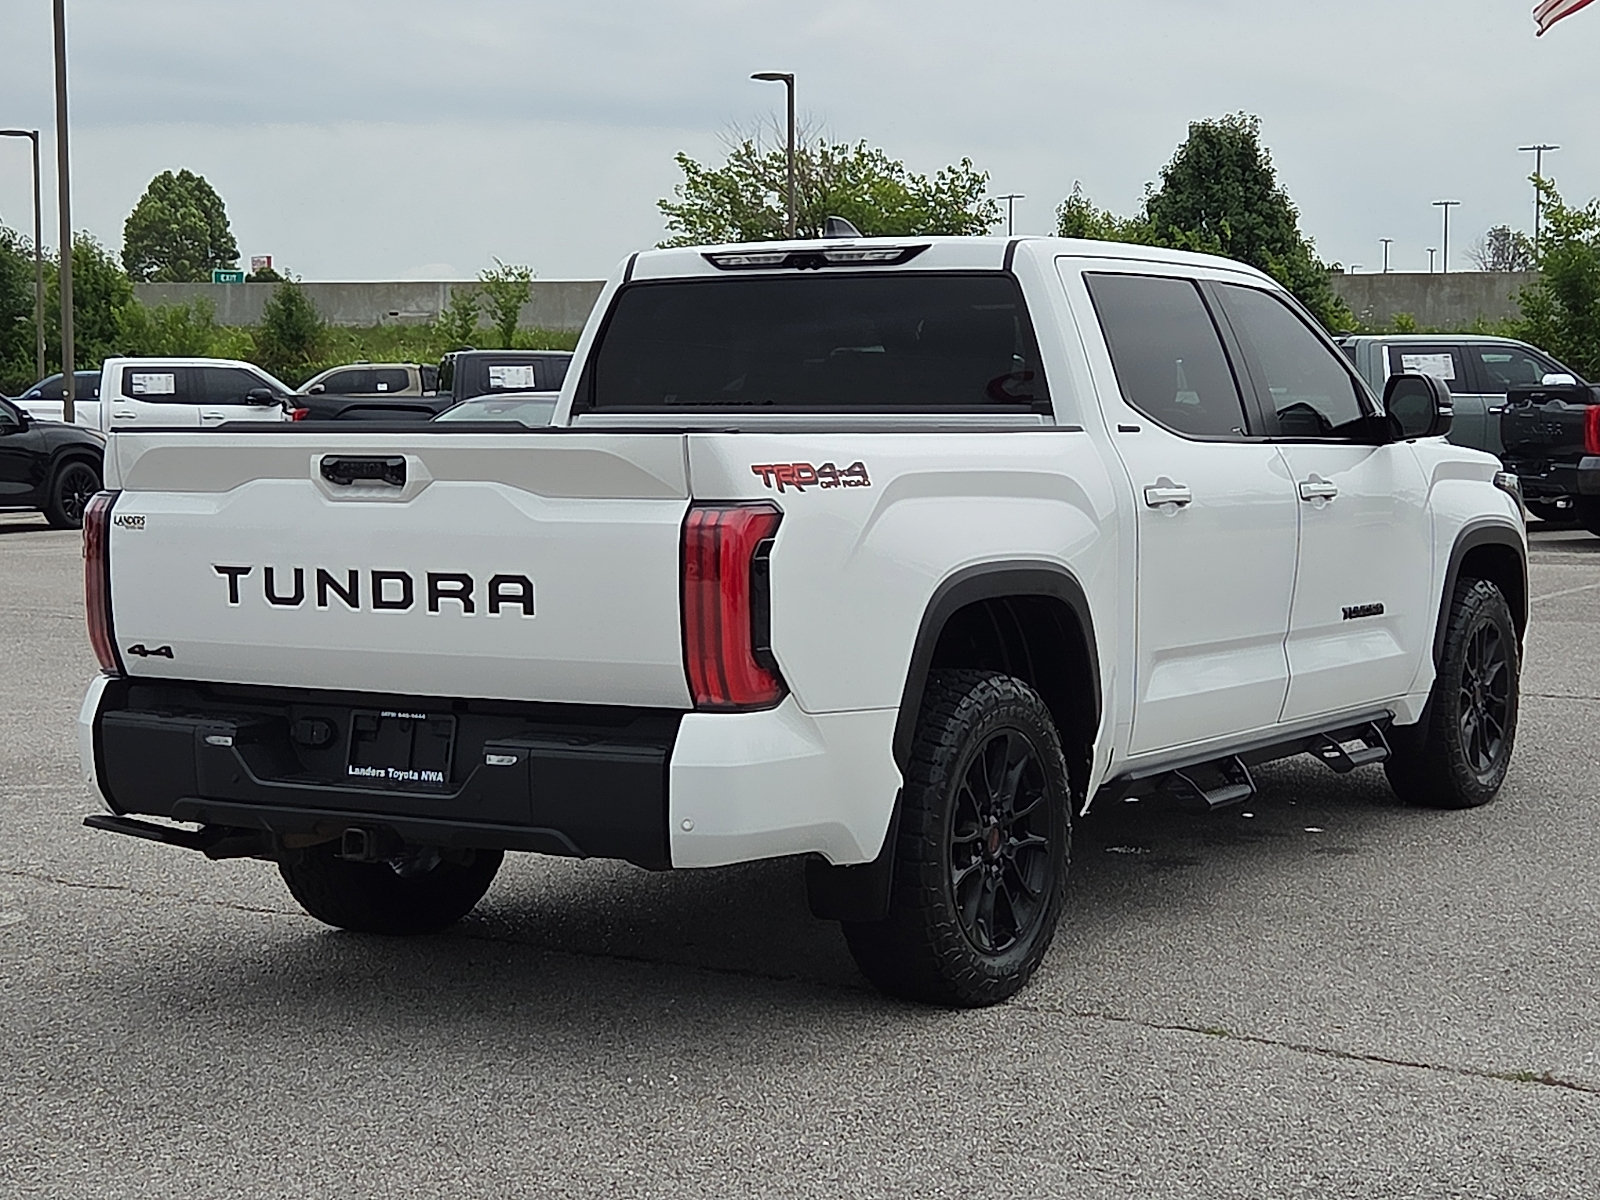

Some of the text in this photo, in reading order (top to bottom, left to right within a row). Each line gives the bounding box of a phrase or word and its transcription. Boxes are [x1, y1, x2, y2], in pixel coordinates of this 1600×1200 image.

[751, 463, 819, 493] TRD
[842, 480, 871, 488] ROAD
[114, 515, 145, 526] LANDERS
[212, 565, 535, 616] TUNDRA
[348, 765, 444, 783] Landers Toyota NWA
